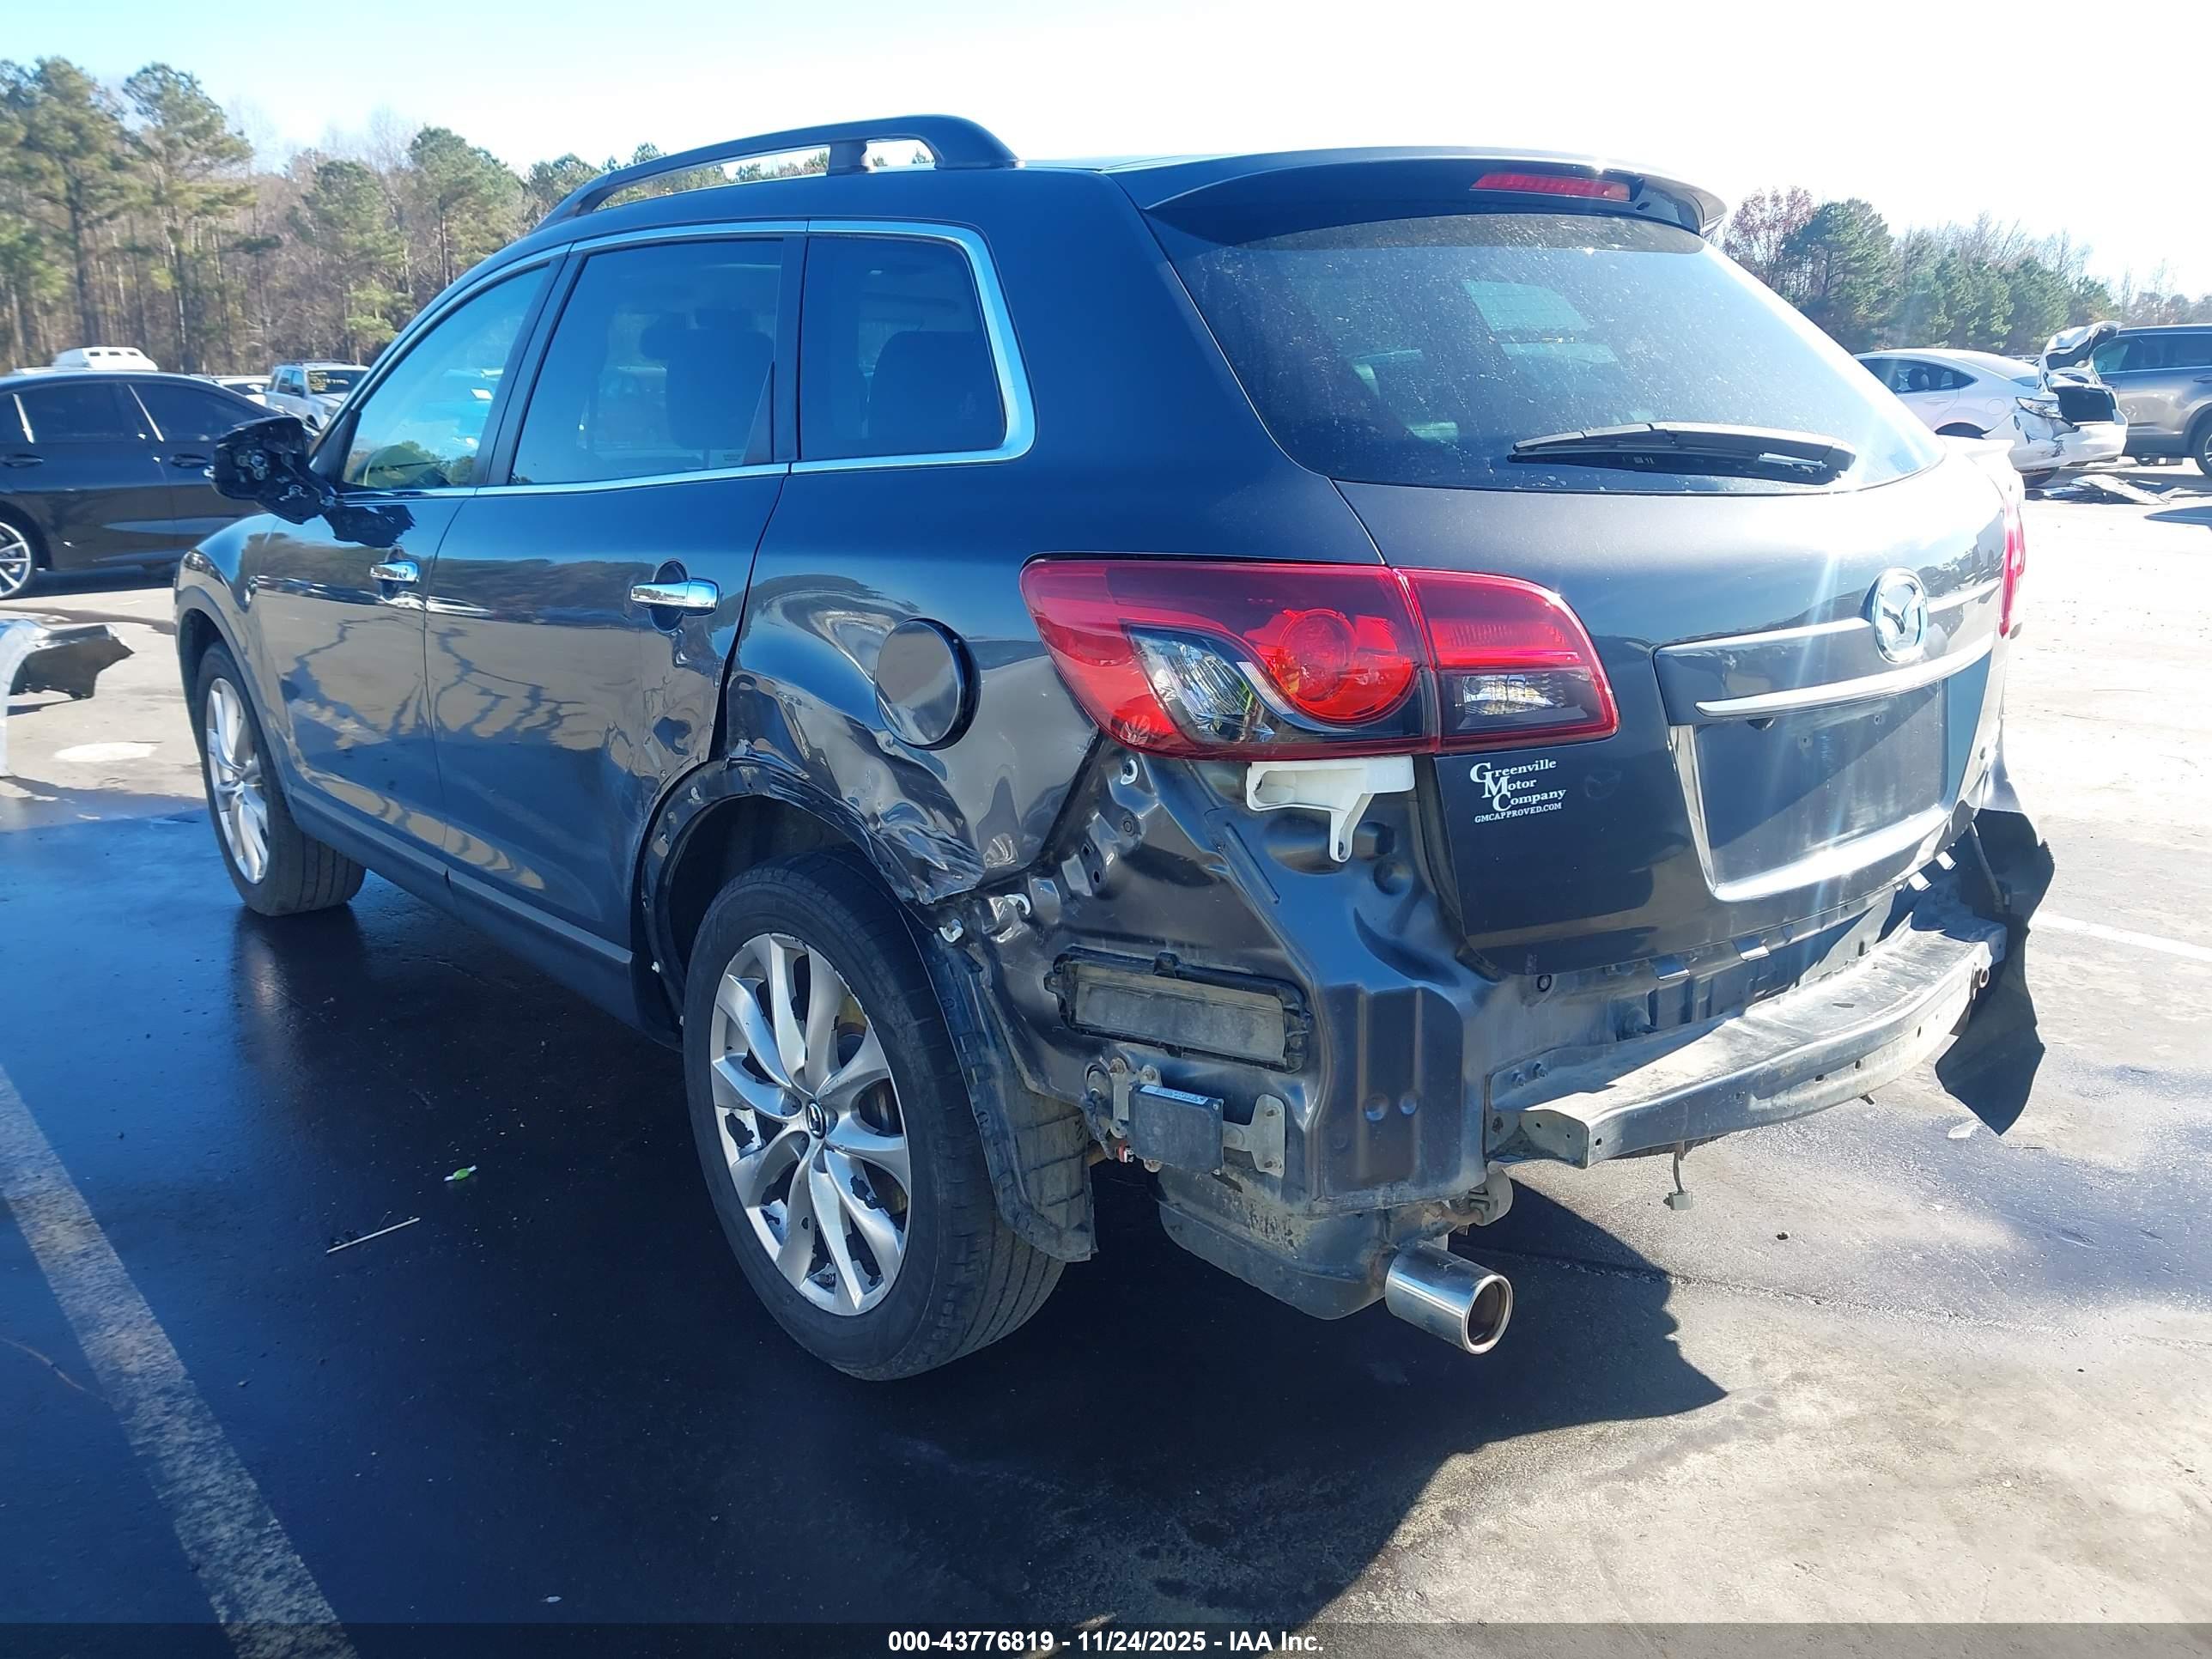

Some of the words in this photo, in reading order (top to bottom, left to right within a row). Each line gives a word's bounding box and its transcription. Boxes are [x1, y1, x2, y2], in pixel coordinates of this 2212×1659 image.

[1470, 759, 1557, 782] Greenville
[1481, 771, 1537, 799] Motor
[1492, 790, 1566, 811] Company
[1474, 802, 1562, 823] GMCAPPROVED.COM
